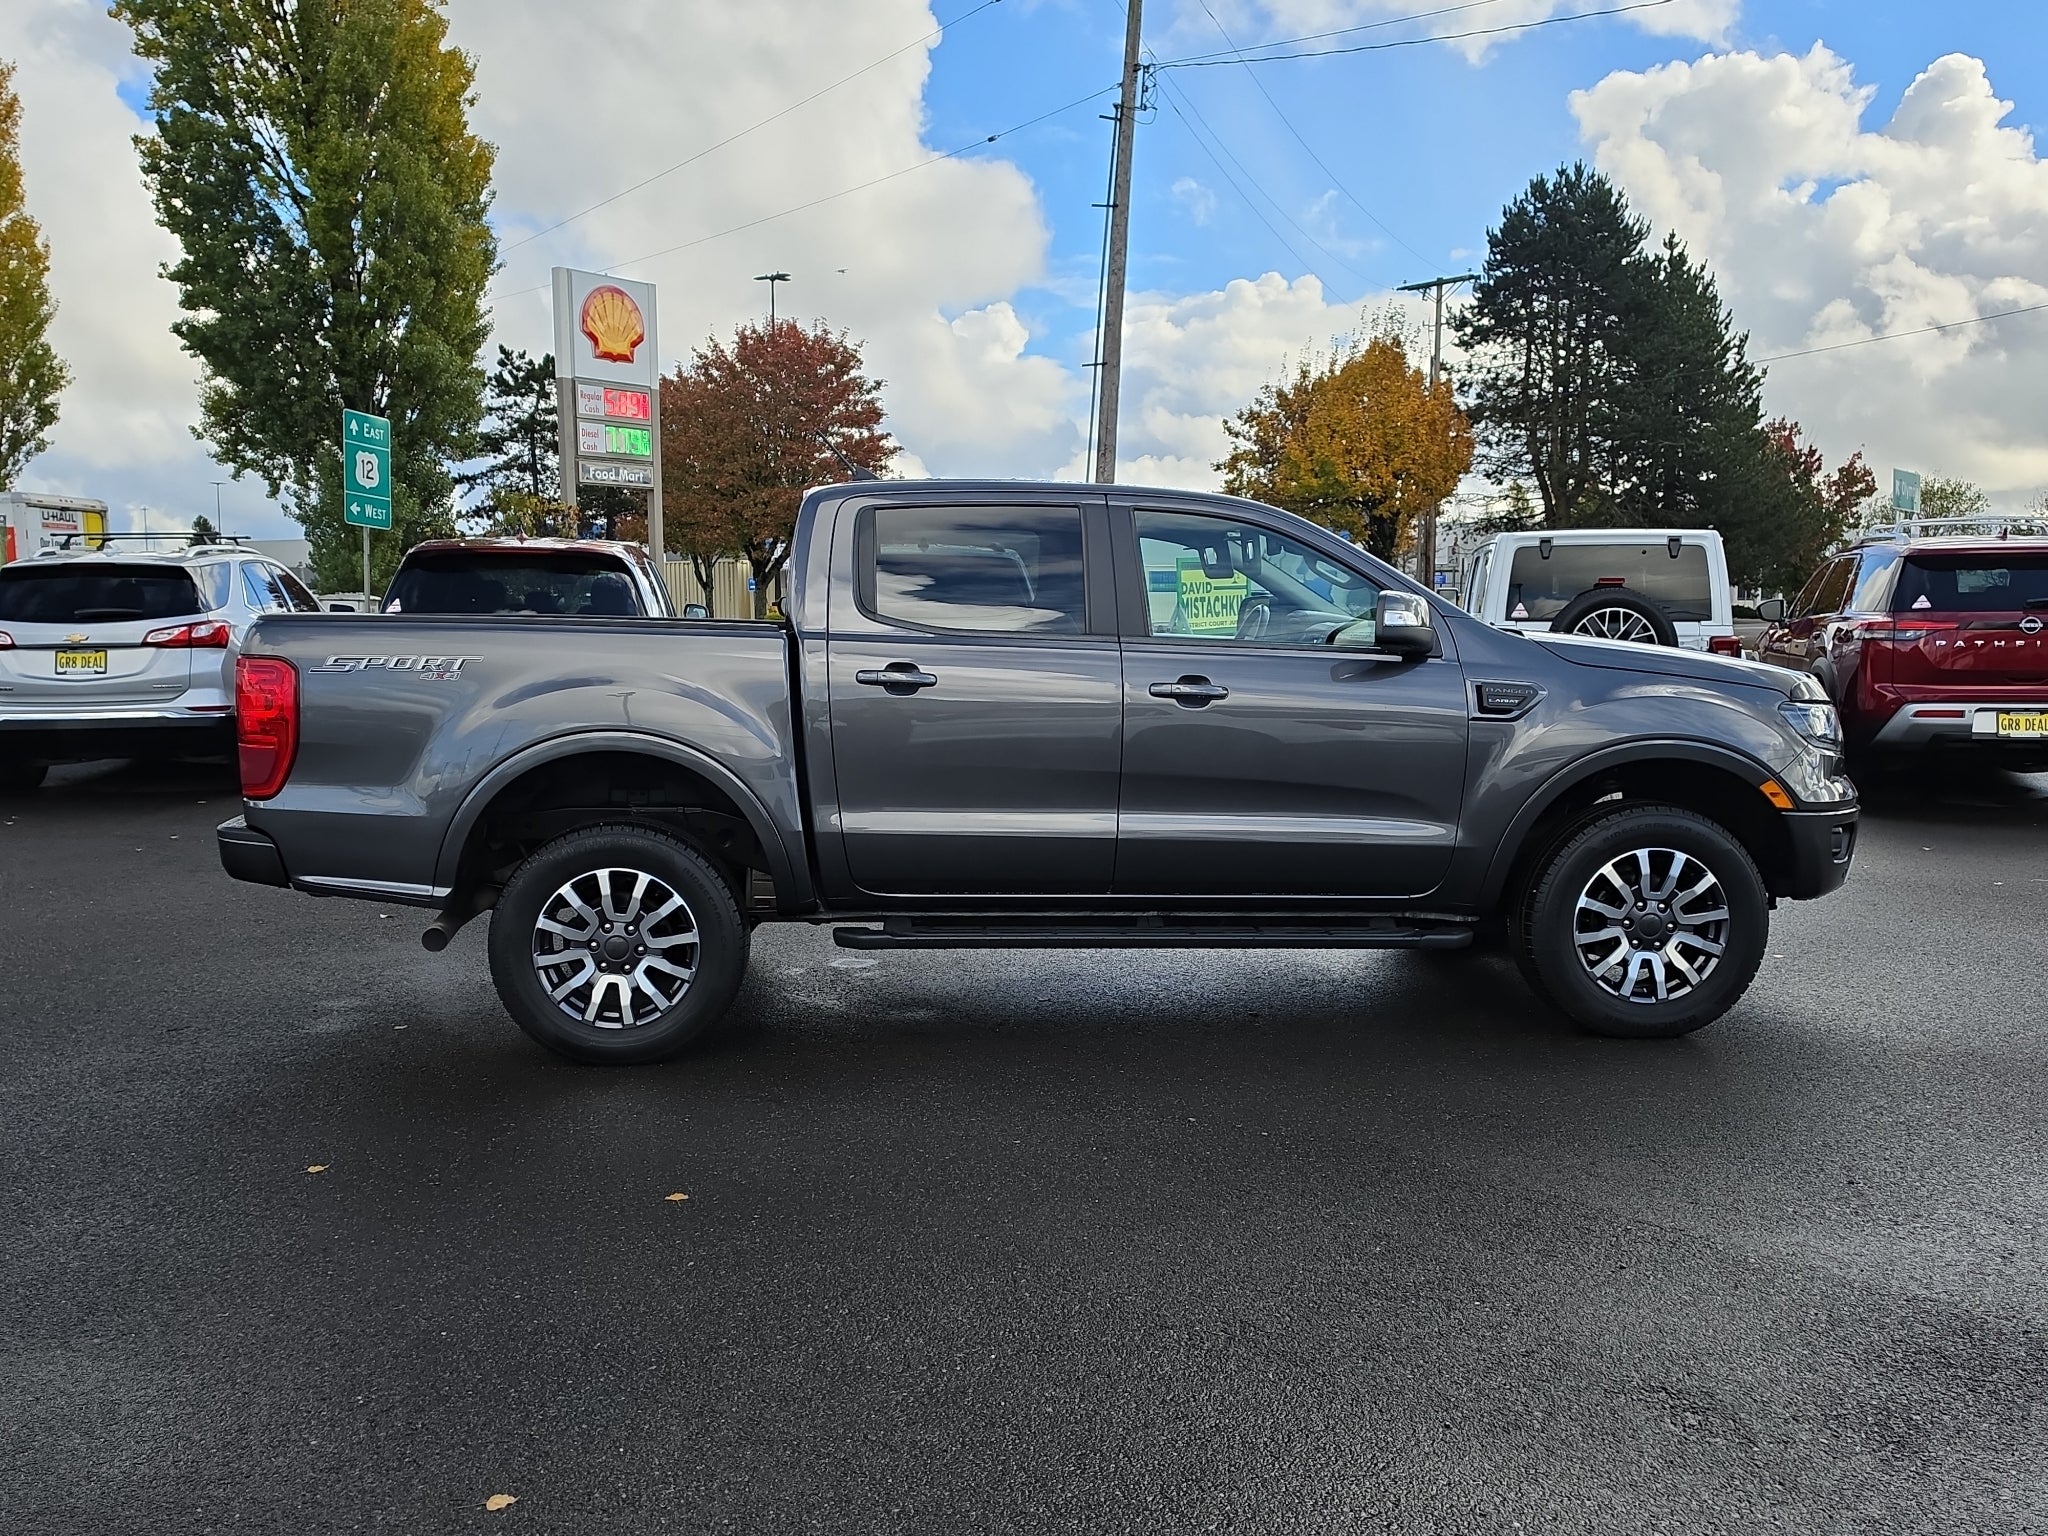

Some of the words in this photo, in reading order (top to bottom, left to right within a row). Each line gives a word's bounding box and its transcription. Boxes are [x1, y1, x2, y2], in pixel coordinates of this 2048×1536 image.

[580, 390, 602, 402] Regular
[584, 405, 600, 414] Cash
[581, 428, 600, 438] Diesel
[582, 441, 598, 450] Cash
[361, 459, 375, 480] 12
[589, 466, 616, 480] Food
[618, 468, 644, 482] Mart
[41, 510, 77, 523] U-HAUL
[1181, 581, 1212, 595] DAVID
[59, 656, 77, 669] GR8
[80, 656, 104, 669] DEAL
[308, 655, 485, 674] SPORT
[1485, 687, 1533, 695] RANGER
[2001, 717, 2021, 731] GR8
[2024, 717, 2048, 732] DEAL
